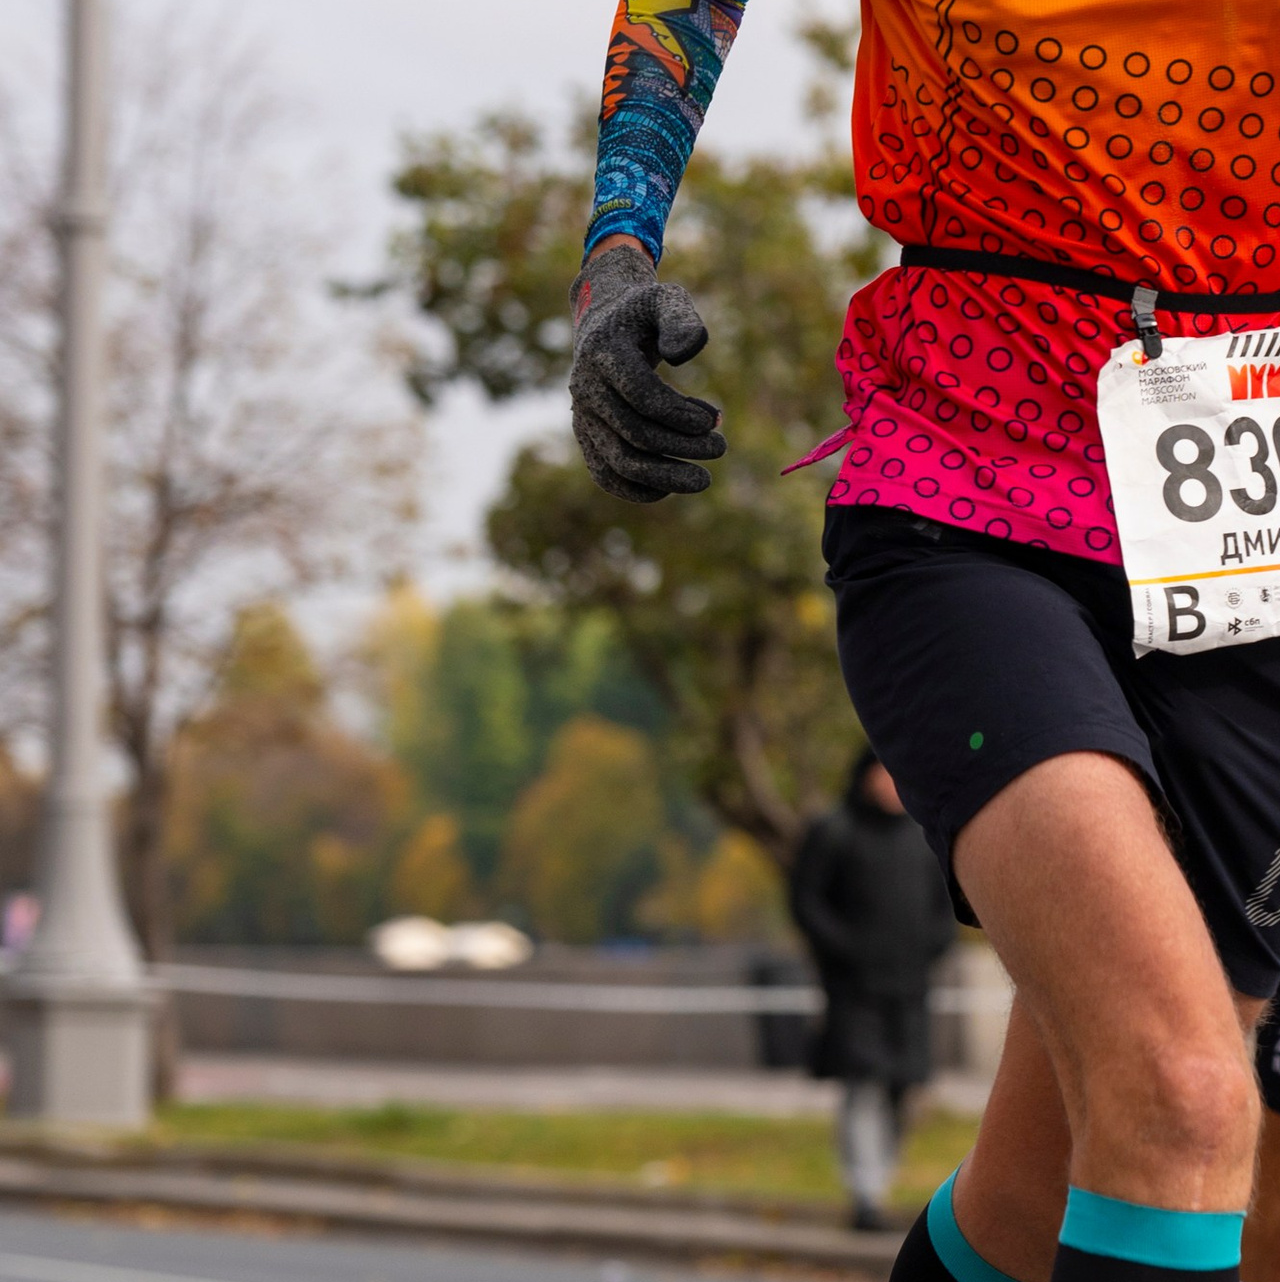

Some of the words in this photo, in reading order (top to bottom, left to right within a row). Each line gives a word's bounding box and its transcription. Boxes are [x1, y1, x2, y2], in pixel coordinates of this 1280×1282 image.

[1138, 362, 1208, 377] МОСКОВСКИЙ
[1138, 374, 1191, 387] МАРАФОН
[1140, 383, 1186, 397] MOSCOW
[1141, 392, 1197, 406] MARATHON
